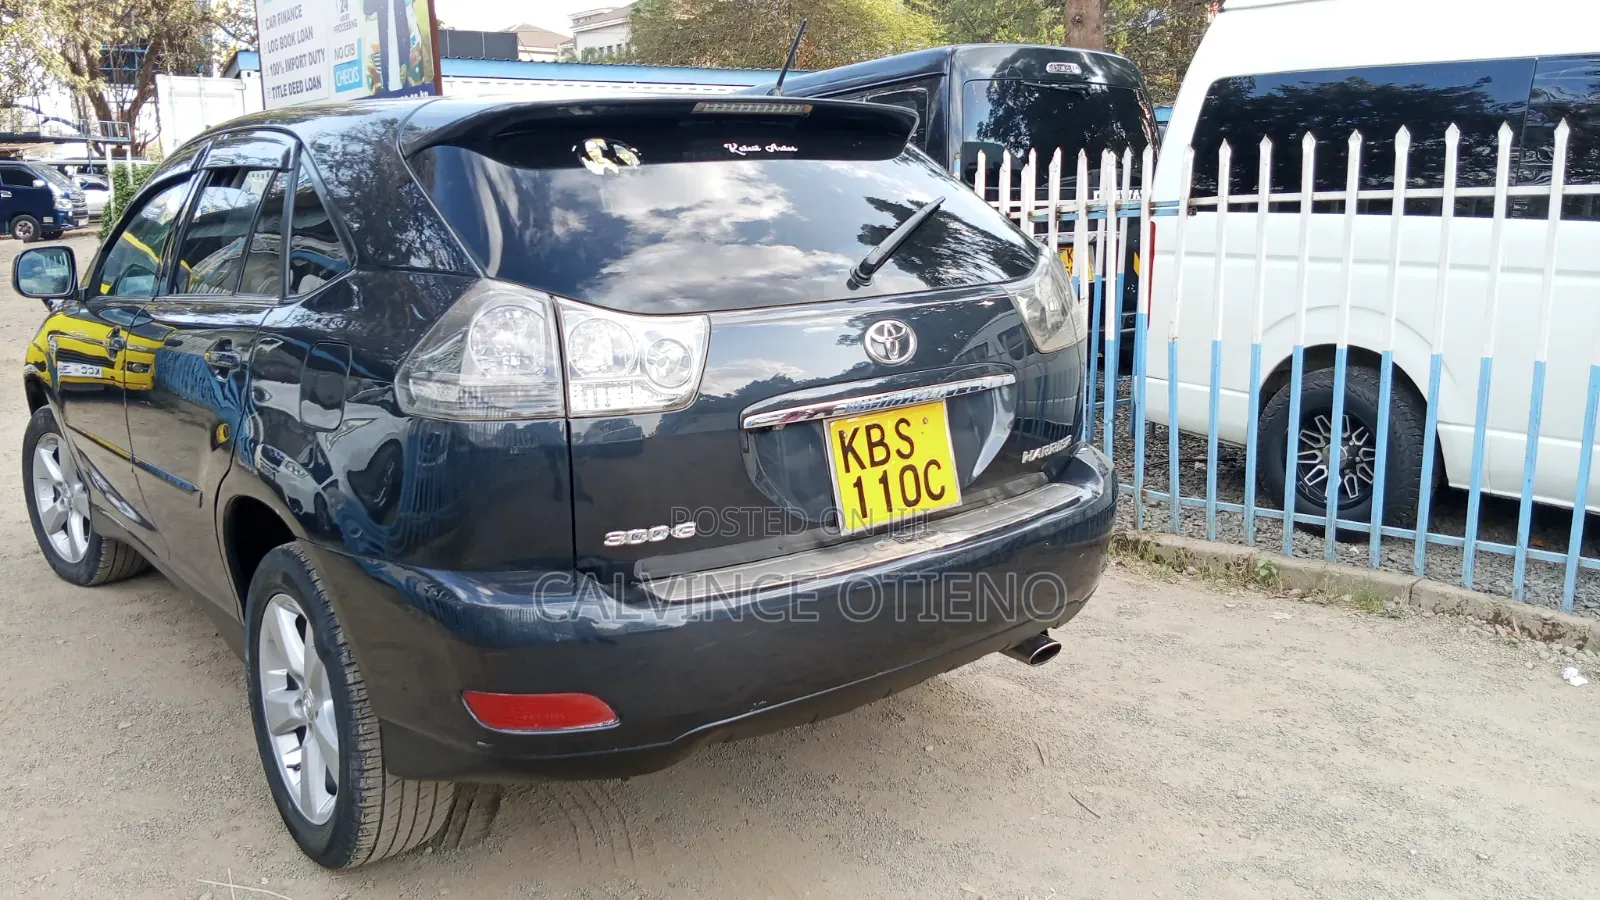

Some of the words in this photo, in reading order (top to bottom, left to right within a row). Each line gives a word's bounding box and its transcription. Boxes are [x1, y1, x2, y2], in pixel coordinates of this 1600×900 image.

[265, 18, 277, 31] CAR
[277, 4, 303, 26] FINANCE
[333, 19, 358, 34] PROCESSING
[267, 38, 279, 54] LOG
[280, 32, 297, 50] BOOK
[297, 26, 314, 44] LOAN
[334, 47, 344, 61] NO
[344, 43, 355, 58] CRB
[269, 61, 285, 76] 100%
[285, 53, 307, 72] IMPORT
[308, 47, 325, 66] DUTY
[271, 84, 288, 99] TITLE
[288, 80, 304, 95] DEED
[304, 74, 322, 92] LOAN
[335, 66, 360, 87] CHECKS
[838, 417, 915, 474] KBS
[852, 458, 946, 519] 110C
[603, 520, 697, 547] 300G
